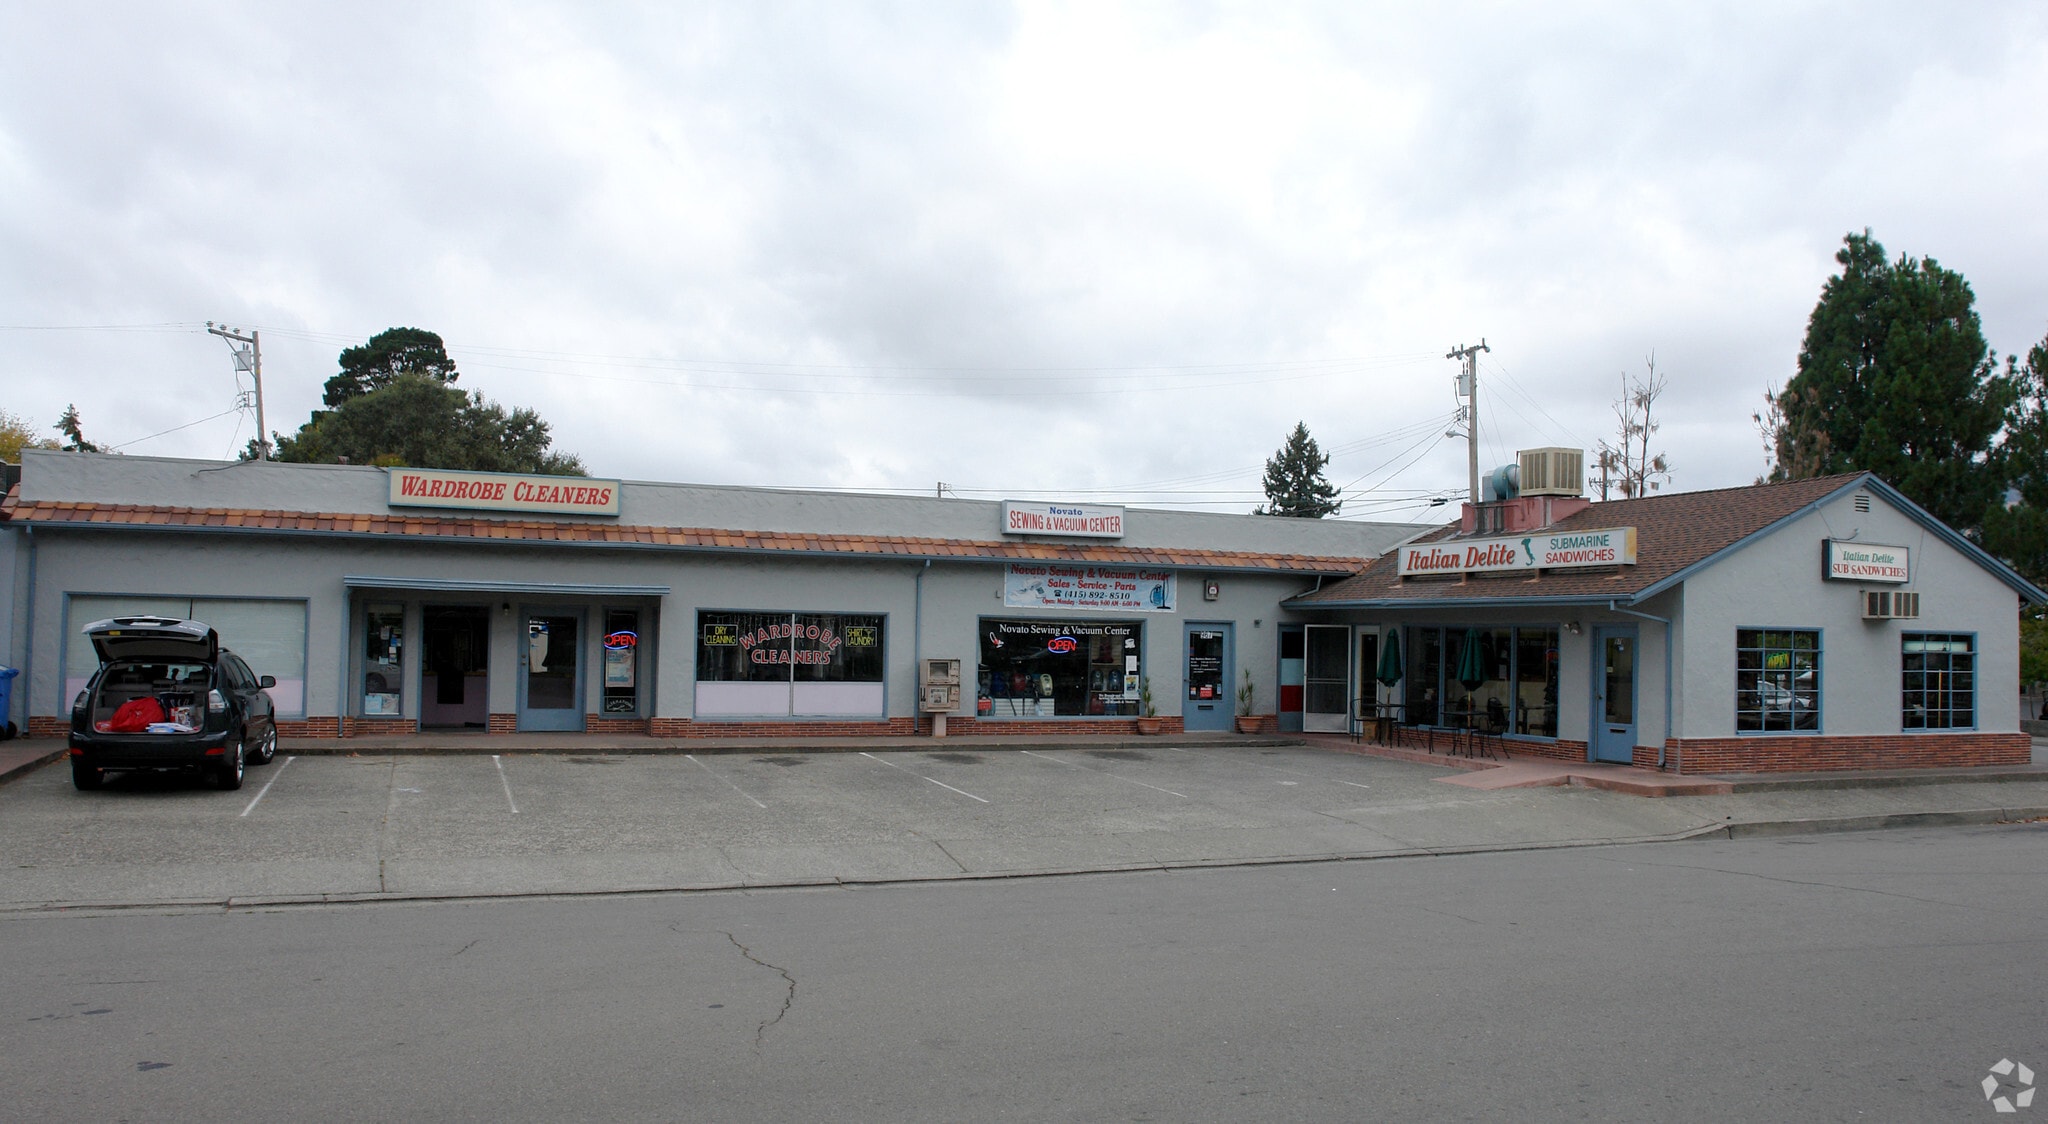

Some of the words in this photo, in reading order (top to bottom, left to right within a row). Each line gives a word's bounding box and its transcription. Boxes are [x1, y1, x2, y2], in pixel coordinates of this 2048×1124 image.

[401, 476, 507, 500] WARDROBE
[513, 481, 612, 506] CLEANERS
[1049, 506, 1083, 516] Novato
[1010, 510, 1044, 530] SEWING
[1046, 517, 1052, 530] &
[1053, 517, 1088, 532] VACUUM
[1089, 515, 1121, 533] CENTER
[1550, 534, 1609, 550] SUBMARINE
[1406, 549, 1460, 571] Italian
[1464, 544, 1516, 568] Delite
[1545, 548, 1615, 564] SANDWICHES
[1843, 551, 1870, 562] Italian
[1872, 553, 1894, 564] Delite
[1011, 564, 1047, 576] Novato
[1048, 566, 1084, 579] Sewing
[1086, 568, 1096, 578] &
[1098, 568, 1136, 580] Vacuum
[1139, 570, 1171, 581] Center
[1833, 563, 1849, 574] SUB
[1851, 565, 1905, 577] SANDWICHES
[1047, 579, 1070, 588] Sales
[1077, 580, 1107, 590] Service
[1114, 582, 1136, 591] Parts
[1064, 591, 1087, 599] (415)
[714, 626, 727, 634] DRY
[847, 628, 863, 637] SHIRT
[999, 624, 1029, 634] Novato
[1030, 624, 1061, 636] Sewing
[1062, 626, 1070, 635] &
[1071, 626, 1103, 635] Vacuum
[1104, 626, 1131, 635] Center
[603, 634, 637, 646] OPEN
[706, 635, 735, 644] CLEANING
[739, 623, 843, 651] WARDROBE
[847, 636, 874, 646] LAUNDRY
[1048, 639, 1077, 651] OPEN
[751, 649, 831, 665] CLEANERS
